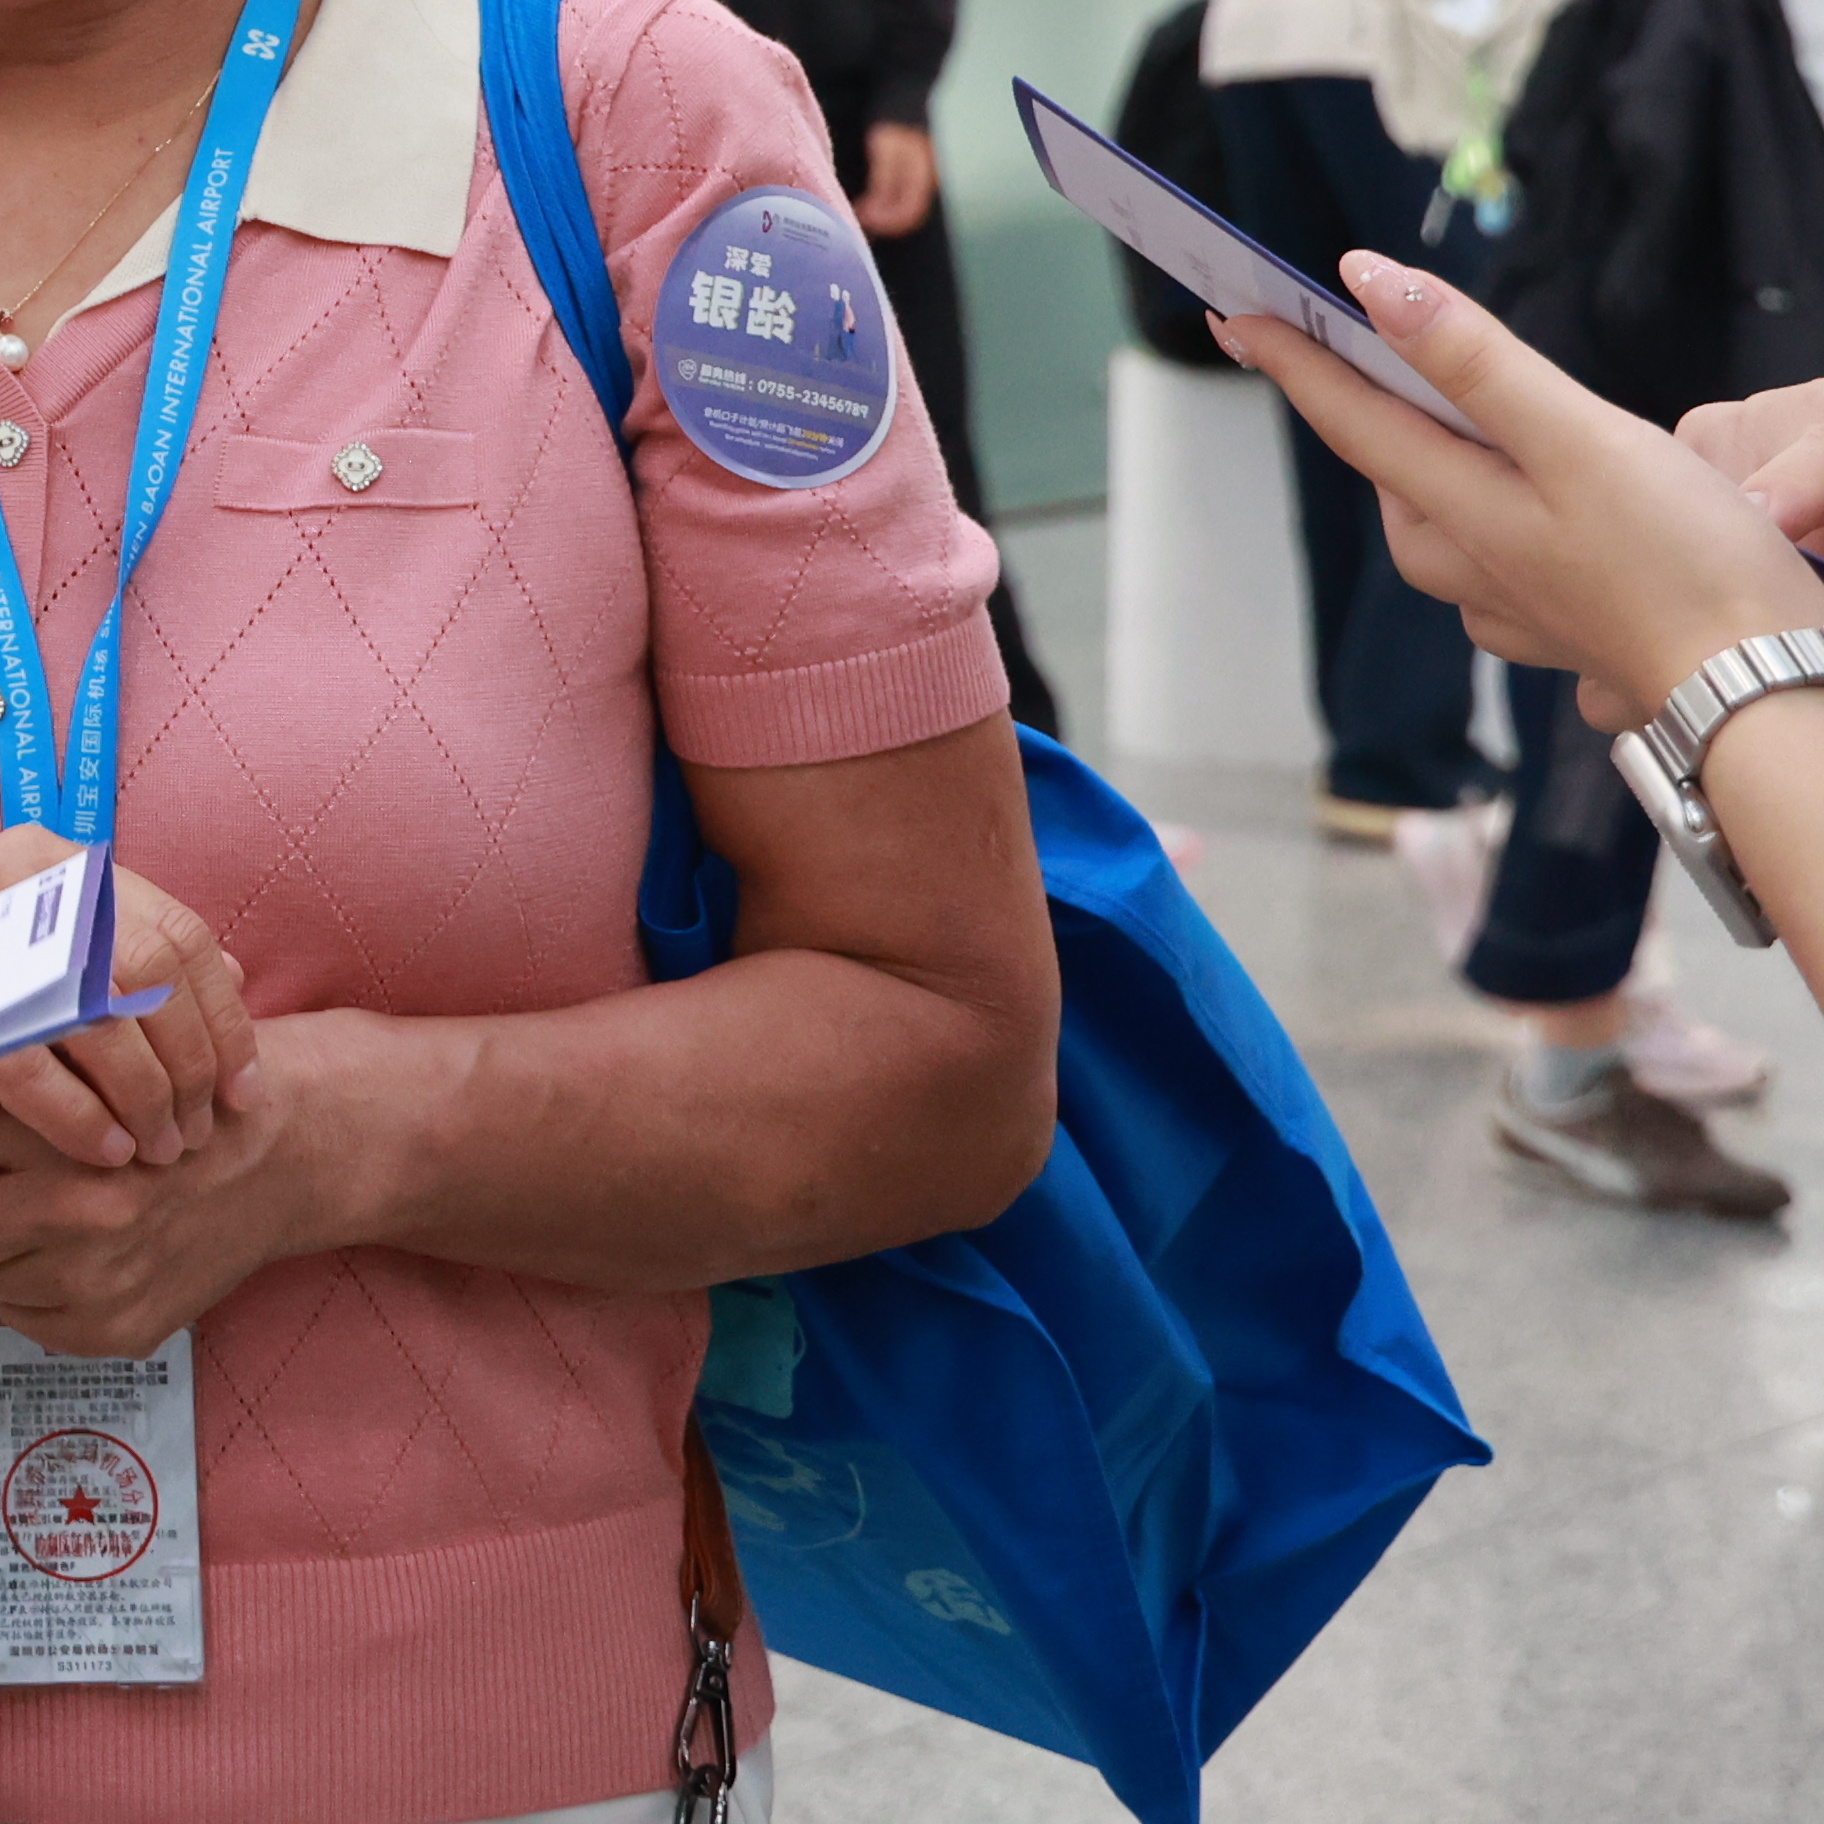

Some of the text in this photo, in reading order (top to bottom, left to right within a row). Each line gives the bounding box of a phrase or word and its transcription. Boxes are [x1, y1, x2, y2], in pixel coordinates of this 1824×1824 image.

[724, 244, 773, 279] 深爱
[141, 429, 173, 516] BAOAN
[160, 240, 213, 425] INTERNATIONAL
[197, 147, 235, 236] AIRPORT
[688, 268, 798, 345] 银龄
